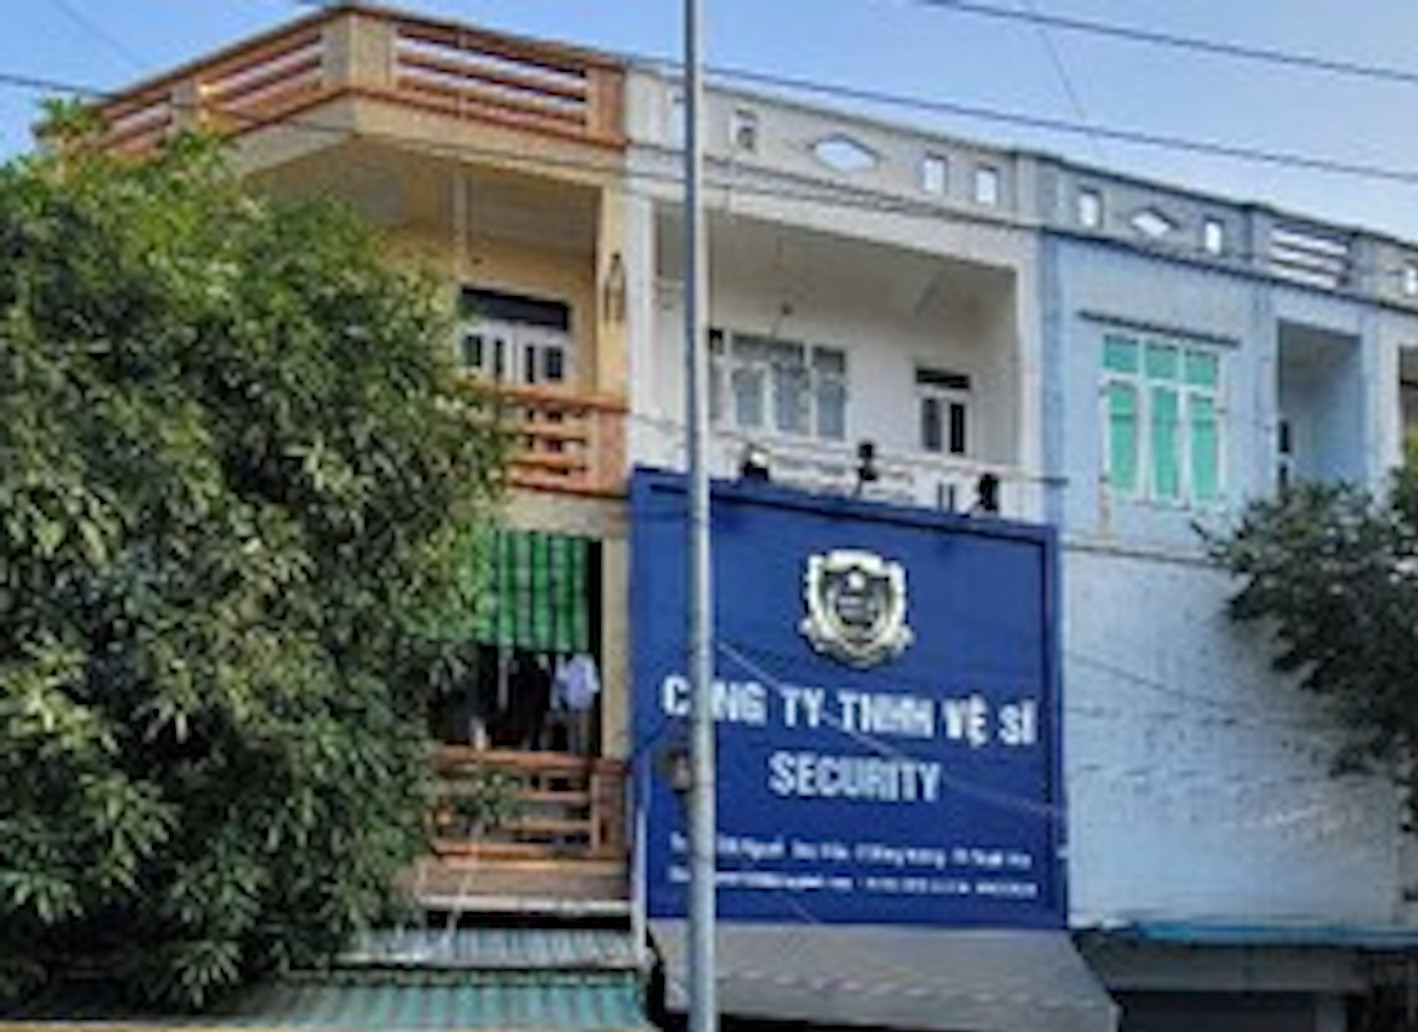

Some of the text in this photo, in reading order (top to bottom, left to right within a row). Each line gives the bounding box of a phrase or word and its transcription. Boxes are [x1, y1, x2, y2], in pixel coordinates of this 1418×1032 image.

[663, 675, 767, 726] CNG
[780, 684, 826, 728] TY
[768, 751, 941, 802] SECURITY
